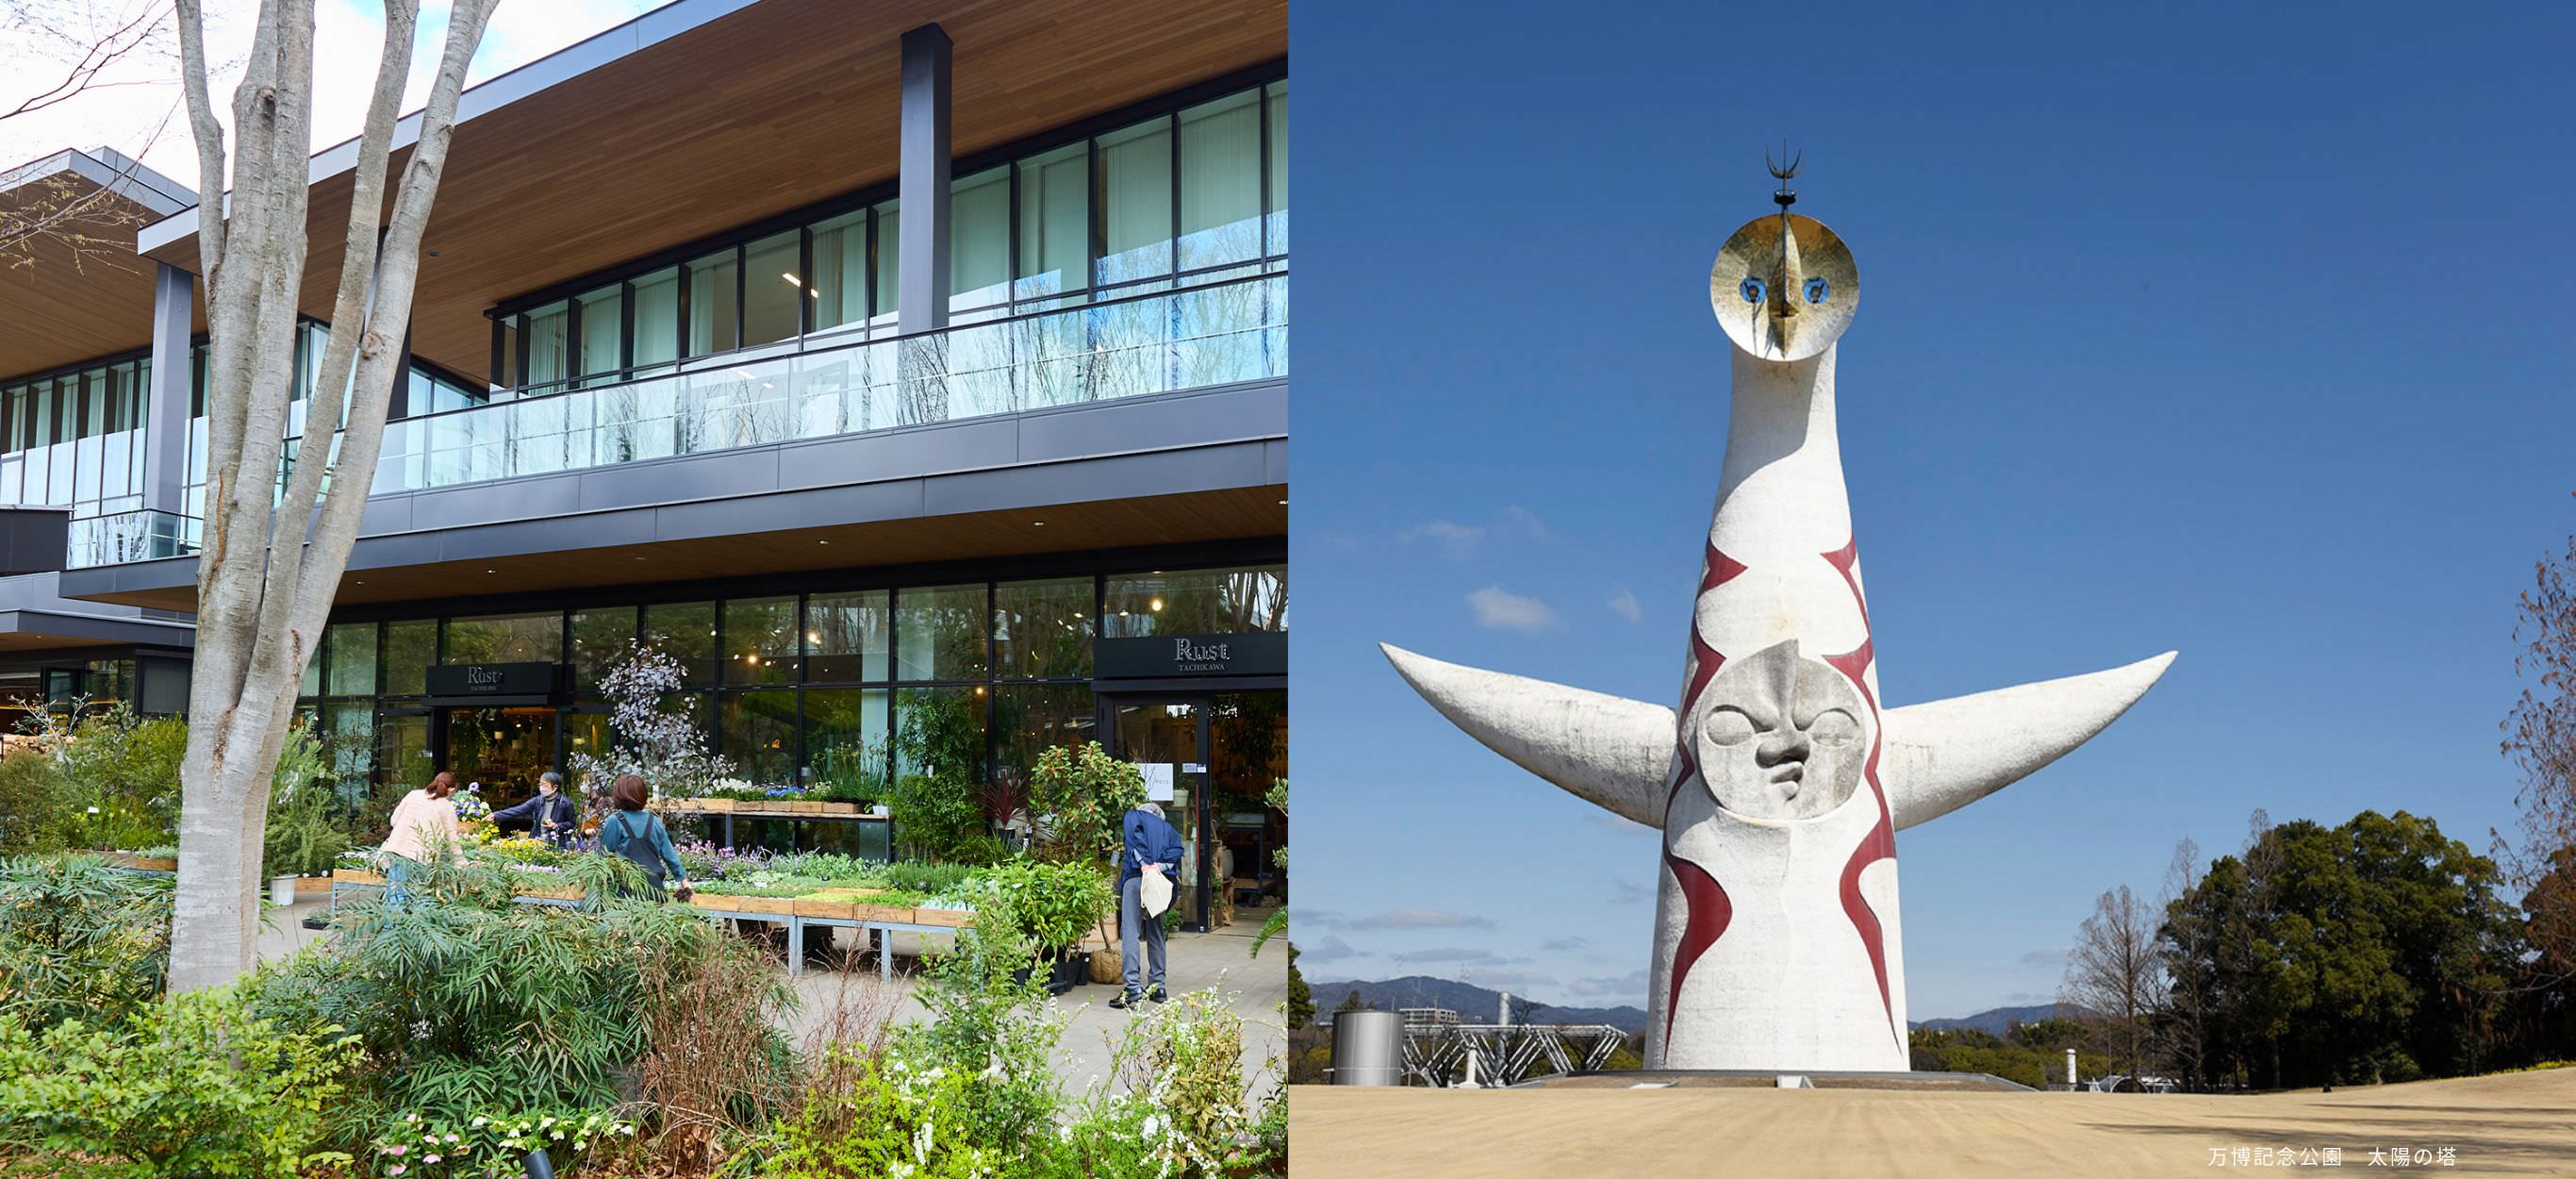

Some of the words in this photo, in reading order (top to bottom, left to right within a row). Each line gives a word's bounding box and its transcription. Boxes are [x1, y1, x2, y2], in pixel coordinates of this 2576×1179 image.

[1174, 638, 1229, 661] Rust
[468, 666, 498, 684] Rust
[1179, 663, 1225, 673] TACHIKAWA
